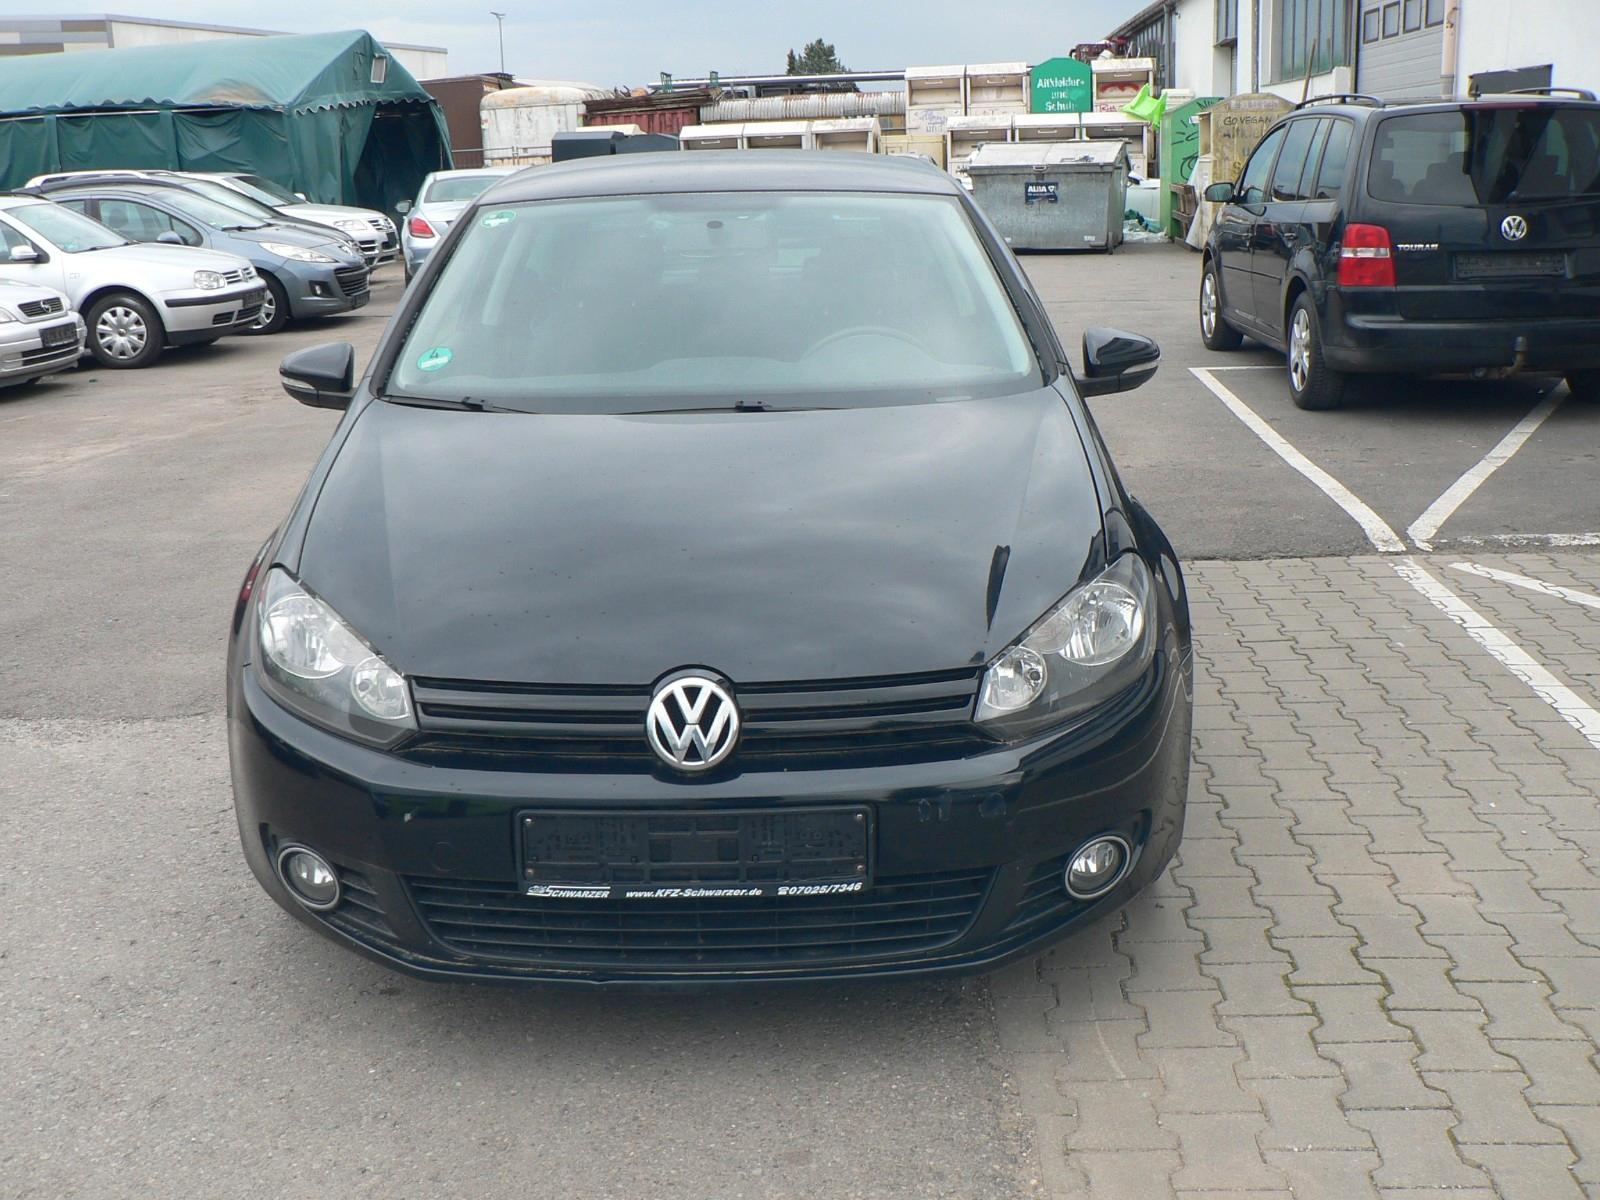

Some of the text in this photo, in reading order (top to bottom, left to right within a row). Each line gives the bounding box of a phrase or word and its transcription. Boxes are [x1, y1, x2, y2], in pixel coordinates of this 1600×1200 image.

[1223, 116, 1238, 126] GO
[1239, 116, 1272, 125] VEGAN
[1396, 243, 1440, 252] TOURAN
[625, 887, 763, 899] www.KFZ-Schwarzer.de
[788, 881, 864, 896] 07025/7346
